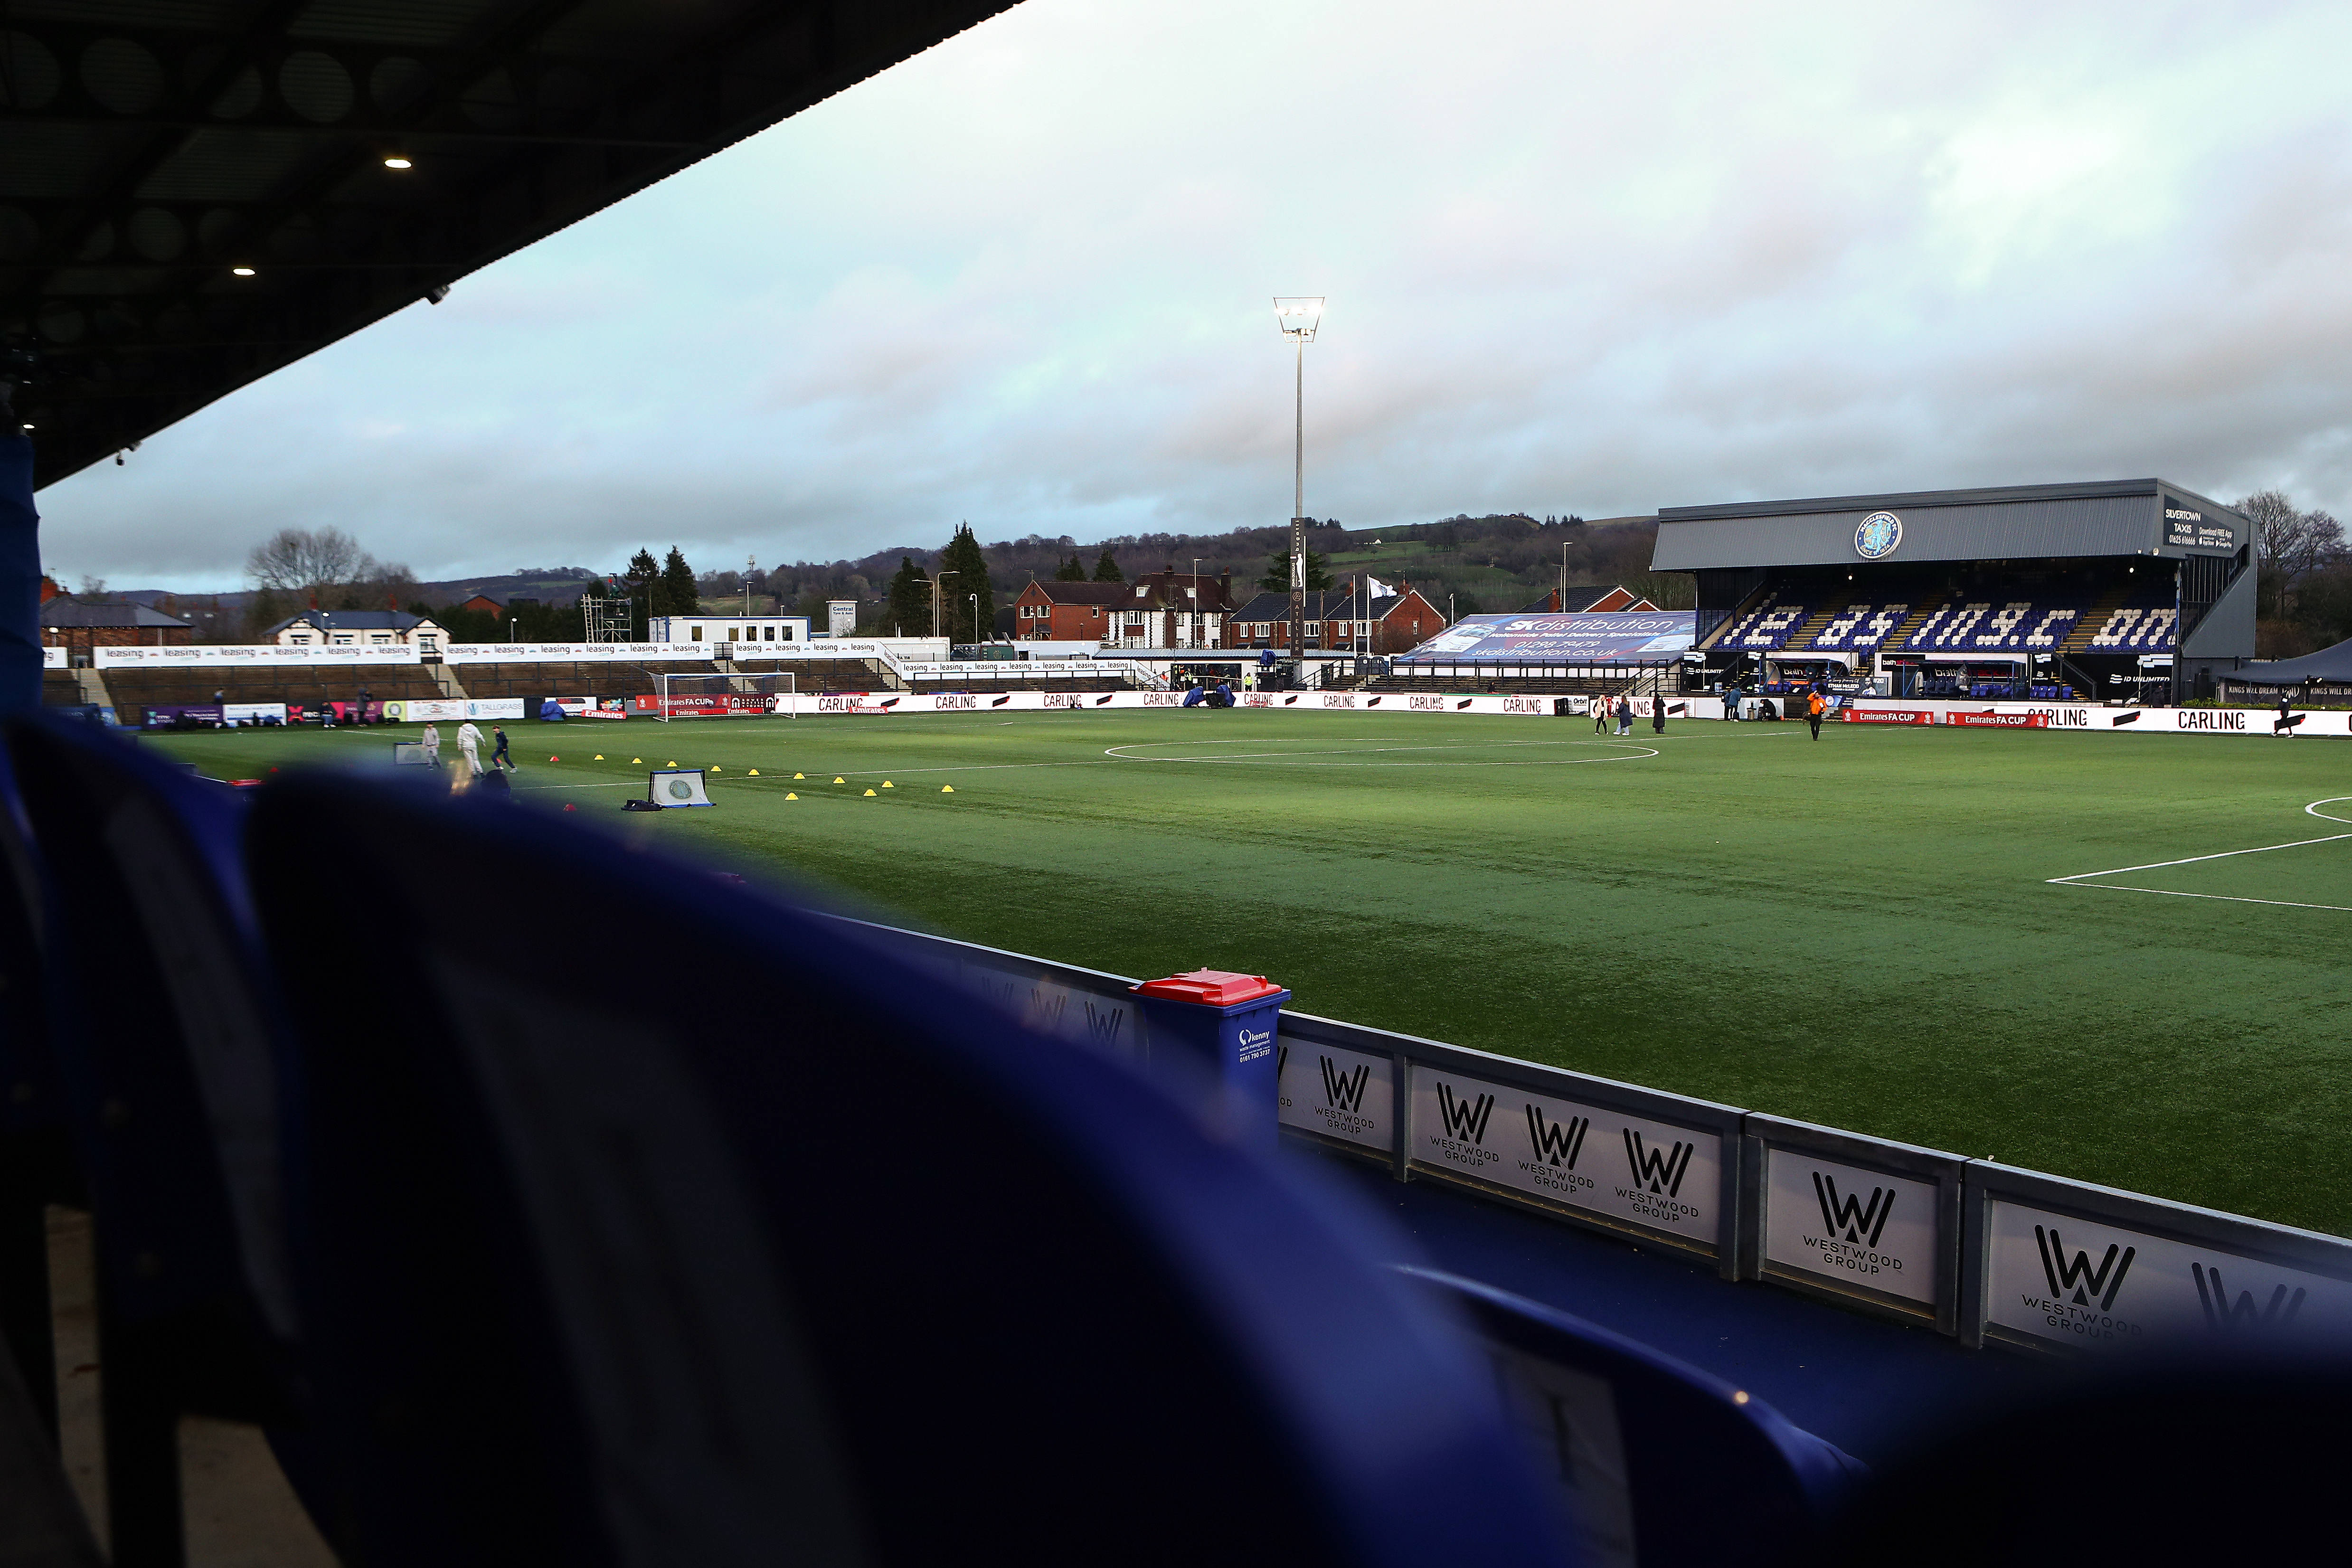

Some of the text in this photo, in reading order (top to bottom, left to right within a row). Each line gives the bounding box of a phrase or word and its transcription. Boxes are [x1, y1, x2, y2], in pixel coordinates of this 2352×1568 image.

[2165, 509, 2201, 521] SILVERTOWN
[1860, 514, 1894, 532] MACCLESFIELD
[2174, 523, 2192, 534] TAXIS
[2169, 534, 2182, 544] 01625
[1860, 545, 1872, 555] SINCE
[446, 645, 478, 655] leasing
[494, 645, 525, 654] leasing
[541, 645, 570, 654] leasing
[586, 644, 614, 654] leasing
[630, 644, 658, 653] leasing
[673, 644, 700, 653] leasing
[737, 643, 762, 652] leasing
[775, 643, 800, 652] leasing
[814, 643, 838, 652] leasing
[851, 643, 875, 652] leasing
[1472, 648, 1618, 657] skdistribution.co.uk
[884, 649, 897, 667] leasing
[904, 664, 927, 672] leasing
[940, 663, 963, 671] leasing
[975, 663, 998, 671] leasing
[1010, 662, 1031, 671] leasing
[1043, 662, 1065, 670] leasing
[1137, 666, 1151, 680] leasing
[2229, 686, 2245, 694] KINGS
[819, 698, 863, 710] CARLING
[935, 696, 976, 708] CARLING
[1044, 695, 1082, 707] CARLING
[1143, 694, 1179, 705] CARLING
[1244, 693, 1273, 705] CARLING
[1324, 696, 1354, 708] CARLING
[1409, 697, 1444, 709] CARLING
[1504, 699, 1541, 712] CARLING
[585, 710, 623, 719] Emirates
[1888, 713, 1899, 721] FA
[1899, 713, 1915, 722] CUP
[1965, 716, 1996, 724] Emirates
[2009, 717, 2027, 725] CUP
[2178, 711, 2245, 730] CARLING
[1252, 1031, 1270, 1041] kenny
[1249, 1039, 1270, 1048] management
[1240, 1055, 1250, 1063] 0161
[1260, 1048, 1270, 1057] 3737
[1315, 1105, 1375, 1130] WESTWOOD
[1327, 1119, 1362, 1135] GROUP
[1429, 1135, 1501, 1164] WESTWOOD
[1445, 1149, 1484, 1168] GROUP
[1518, 1159, 1595, 1190] WESTWOOD
[1534, 1175, 1578, 1195] GROUP
[1615, 1186, 1700, 1219] WESTWOOD
[1632, 1202, 1680, 1223] GROUP
[1802, 1235, 1904, 1271] WESTWOOD
[1823, 1252, 1880, 1277] GROUP
[2021, 1294, 2142, 1337] WESTWOOD
[2046, 1315, 2114, 1342] GROUP
